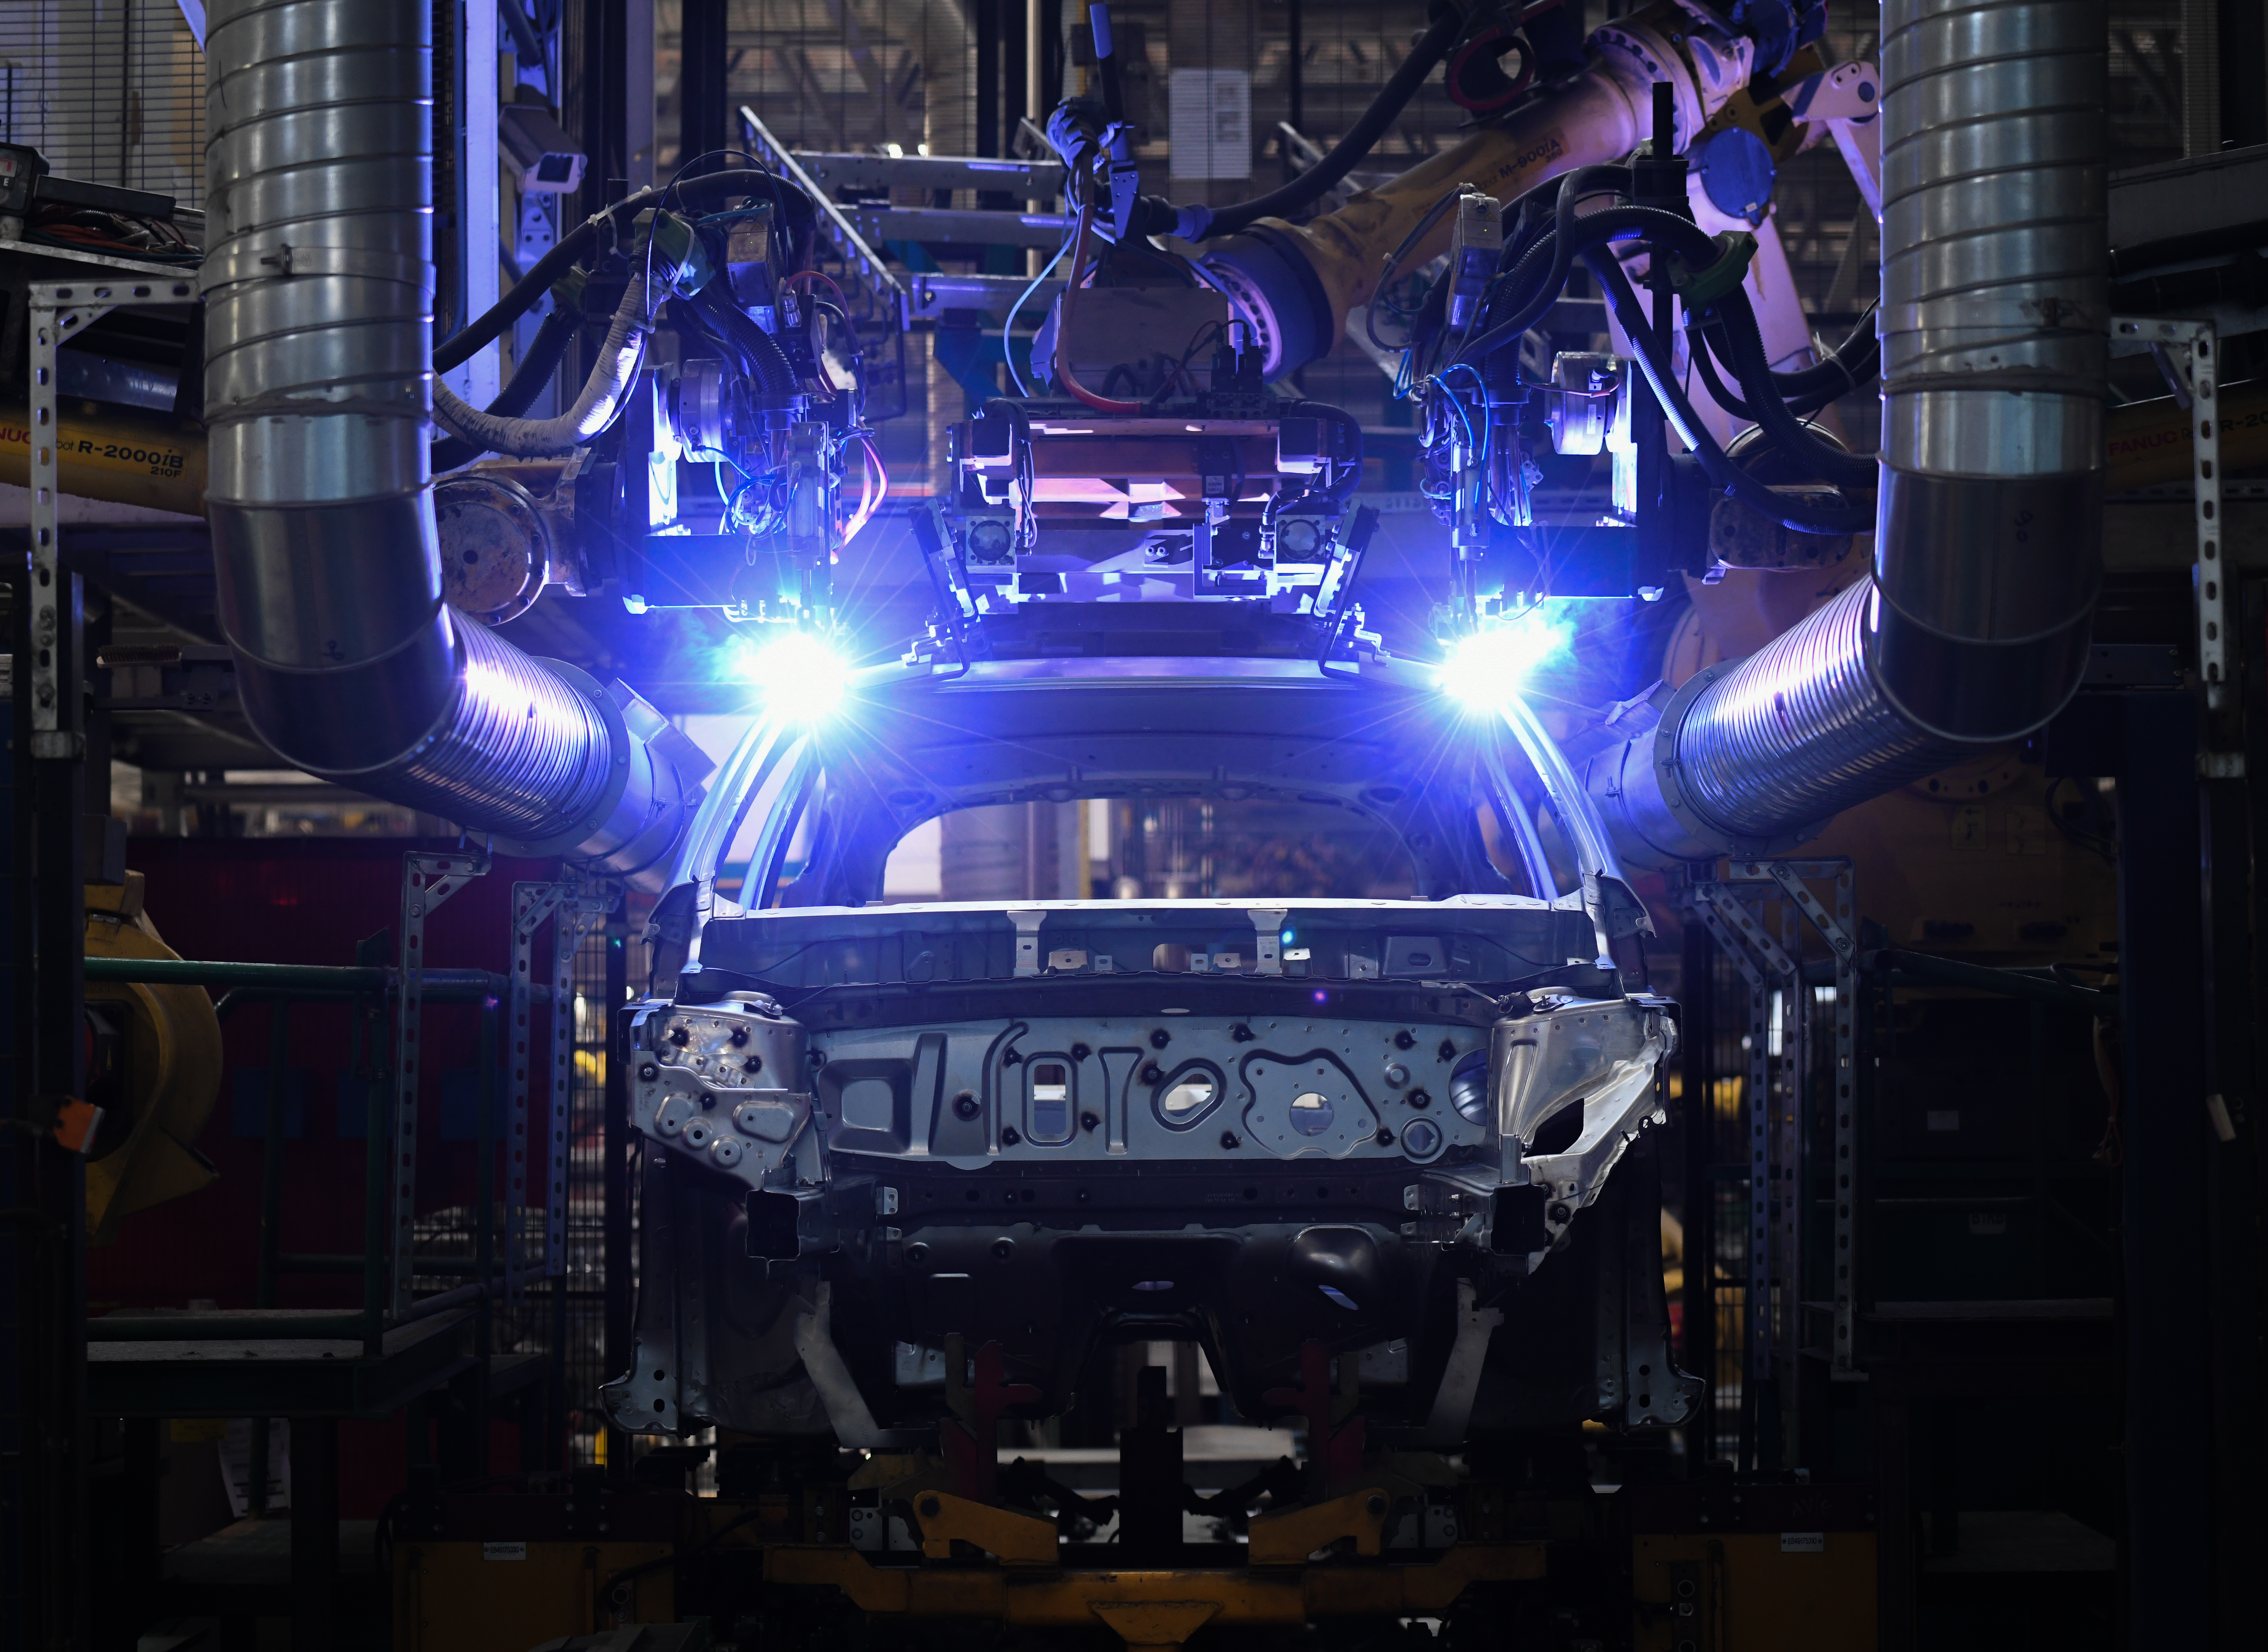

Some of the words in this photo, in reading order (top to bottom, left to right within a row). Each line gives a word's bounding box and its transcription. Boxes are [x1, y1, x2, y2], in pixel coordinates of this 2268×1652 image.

[1499, 136, 1561, 179] M-900iA
[79, 440, 183, 469] R-2000iB
[2108, 430, 2178, 456] FANUC
[150, 466, 182, 478] 210F
